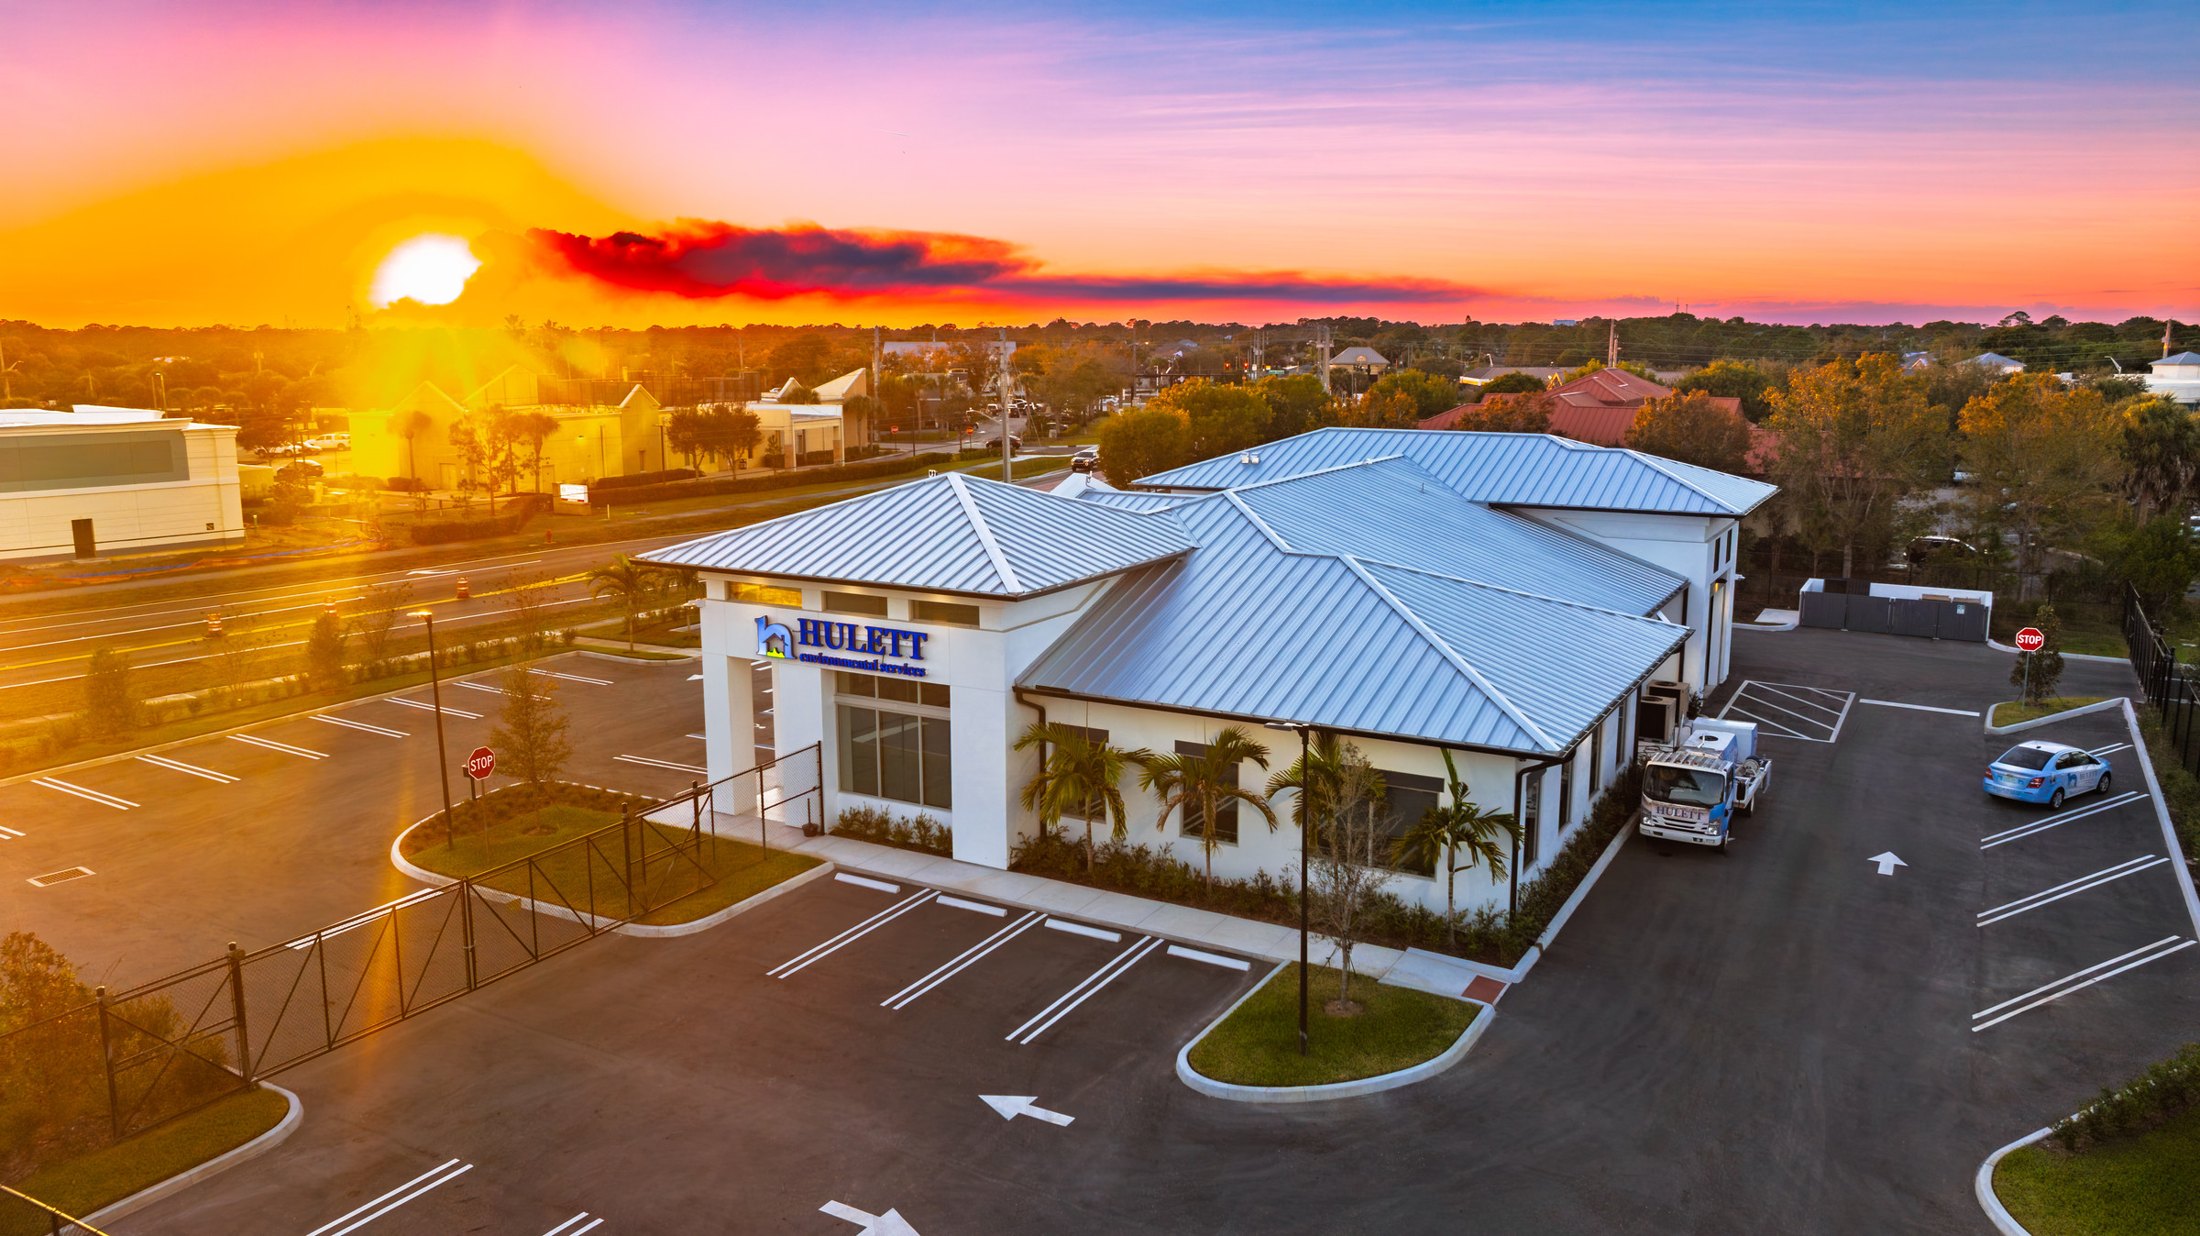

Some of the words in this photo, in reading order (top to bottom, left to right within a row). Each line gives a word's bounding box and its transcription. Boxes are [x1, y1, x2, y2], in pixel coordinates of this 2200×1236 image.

[797, 618, 928, 660] HULETT
[2018, 634, 2042, 645] STOP
[799, 652, 879, 672] environmental
[879, 662, 927, 677] services
[470, 755, 493, 772] STOP
[1656, 806, 1704, 820] HULETT
